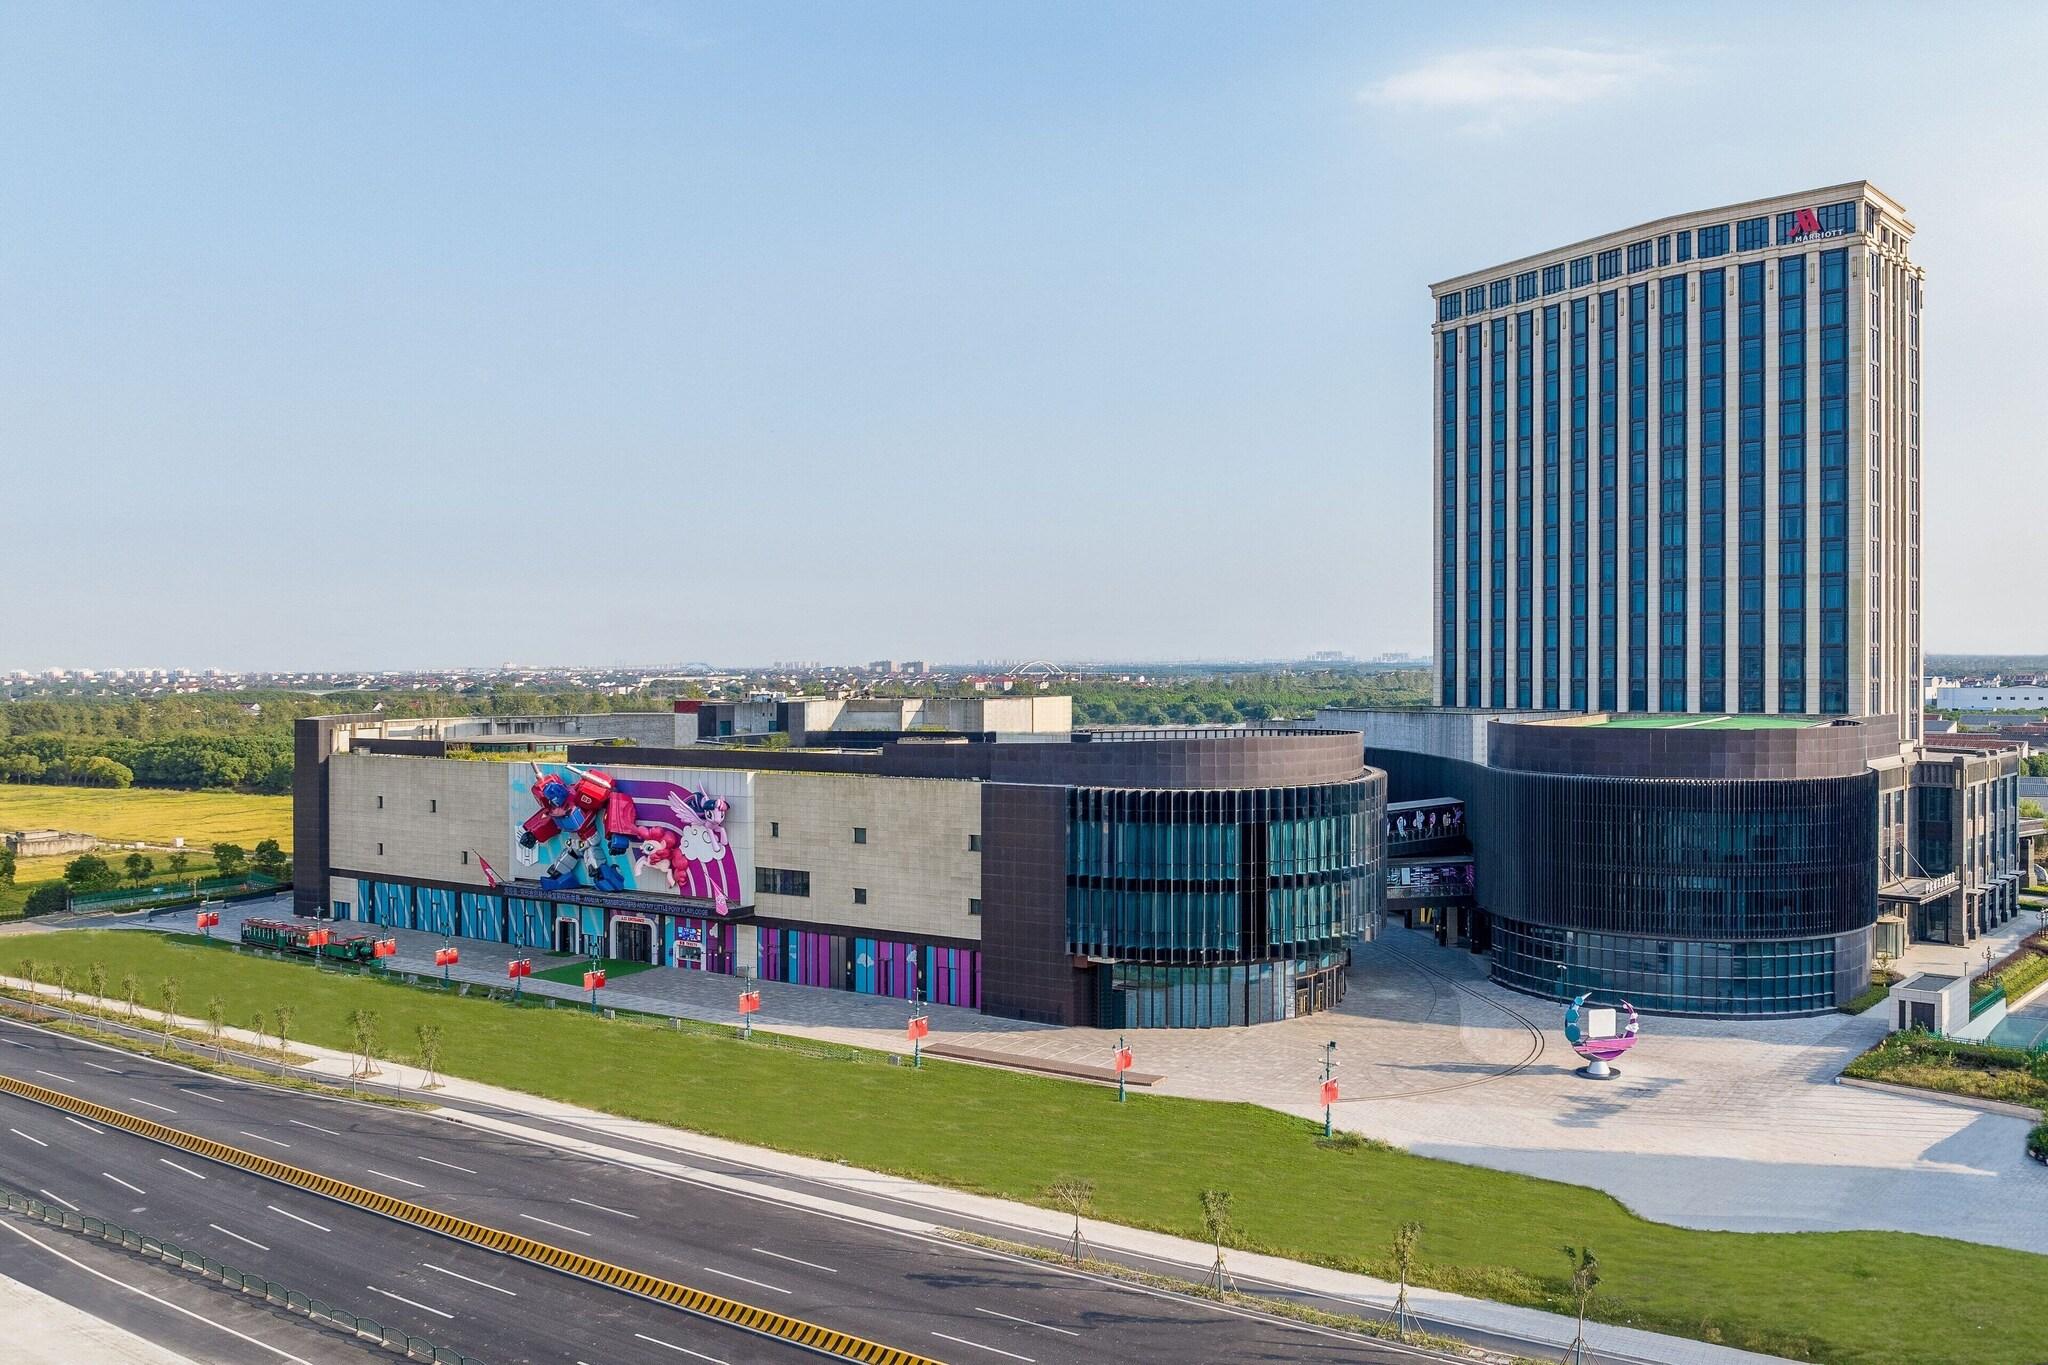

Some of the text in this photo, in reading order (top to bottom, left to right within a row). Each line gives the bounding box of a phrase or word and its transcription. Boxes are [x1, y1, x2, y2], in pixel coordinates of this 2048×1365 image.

[1795, 229, 1844, 242] MARRIOTT
[654, 903, 668, 912] LITTLE
[668, 905, 681, 914] PONY
